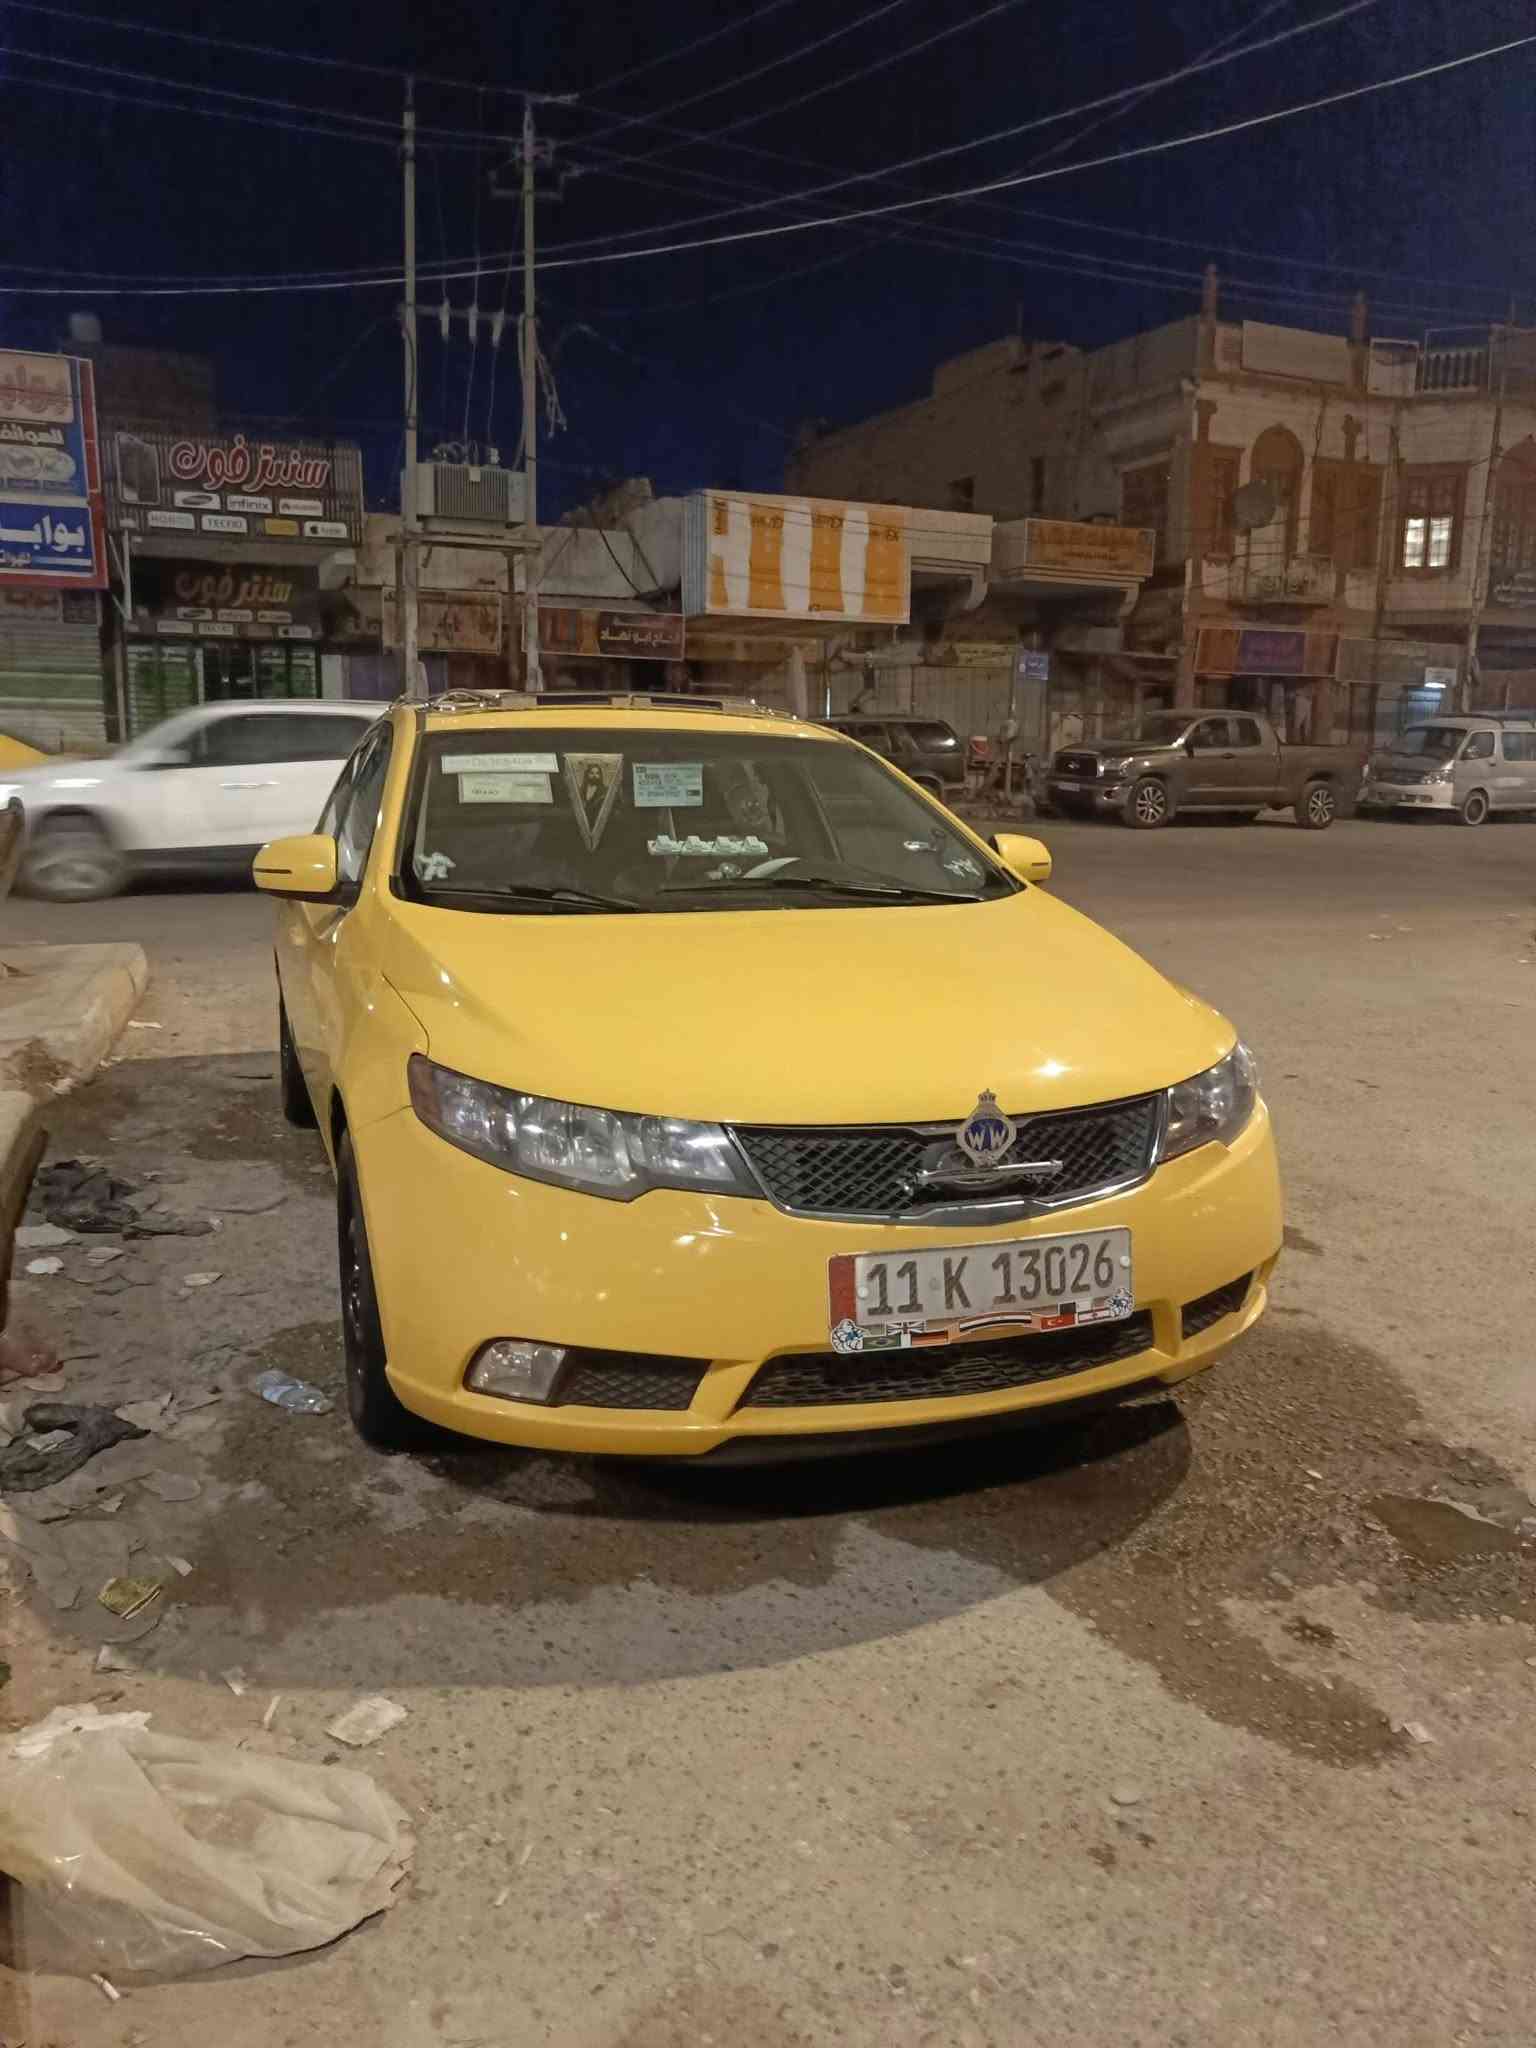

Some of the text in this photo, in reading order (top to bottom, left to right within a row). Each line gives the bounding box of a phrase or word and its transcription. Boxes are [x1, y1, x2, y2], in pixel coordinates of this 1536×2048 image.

[169, 434, 252, 491] فون
[867, 1239, 1114, 1316] 11 K 13026
